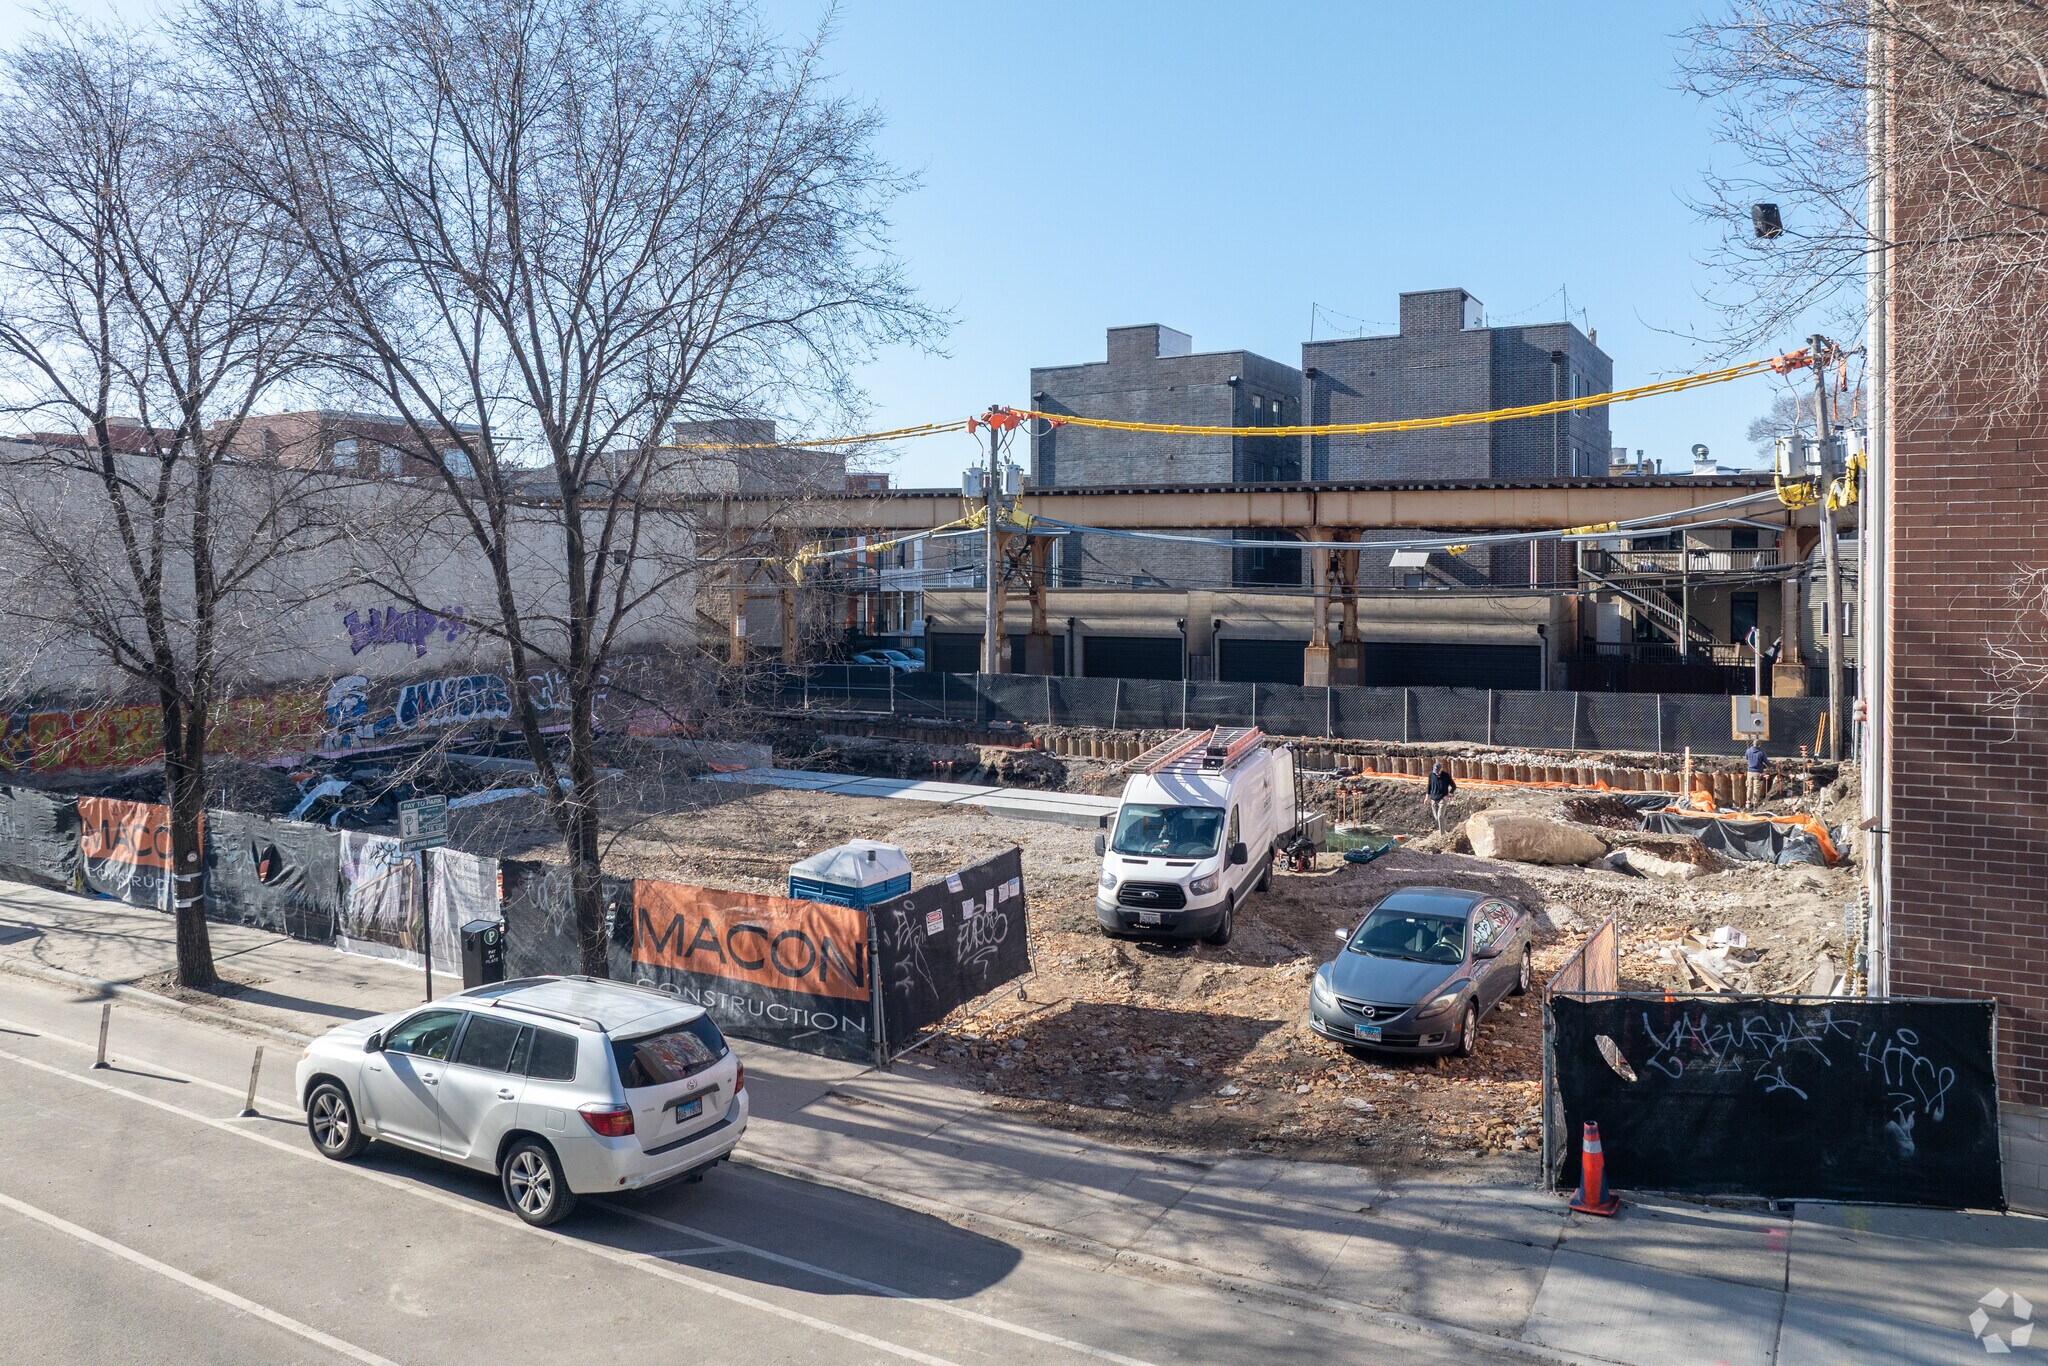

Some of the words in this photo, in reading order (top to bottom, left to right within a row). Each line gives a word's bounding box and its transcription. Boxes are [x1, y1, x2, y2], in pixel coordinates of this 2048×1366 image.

[403, 802, 415, 810] PAY
[426, 797, 443, 806] PARK
[81, 818, 174, 859] MACO
[488, 930, 496, 942] P
[638, 907, 865, 988] MACON
